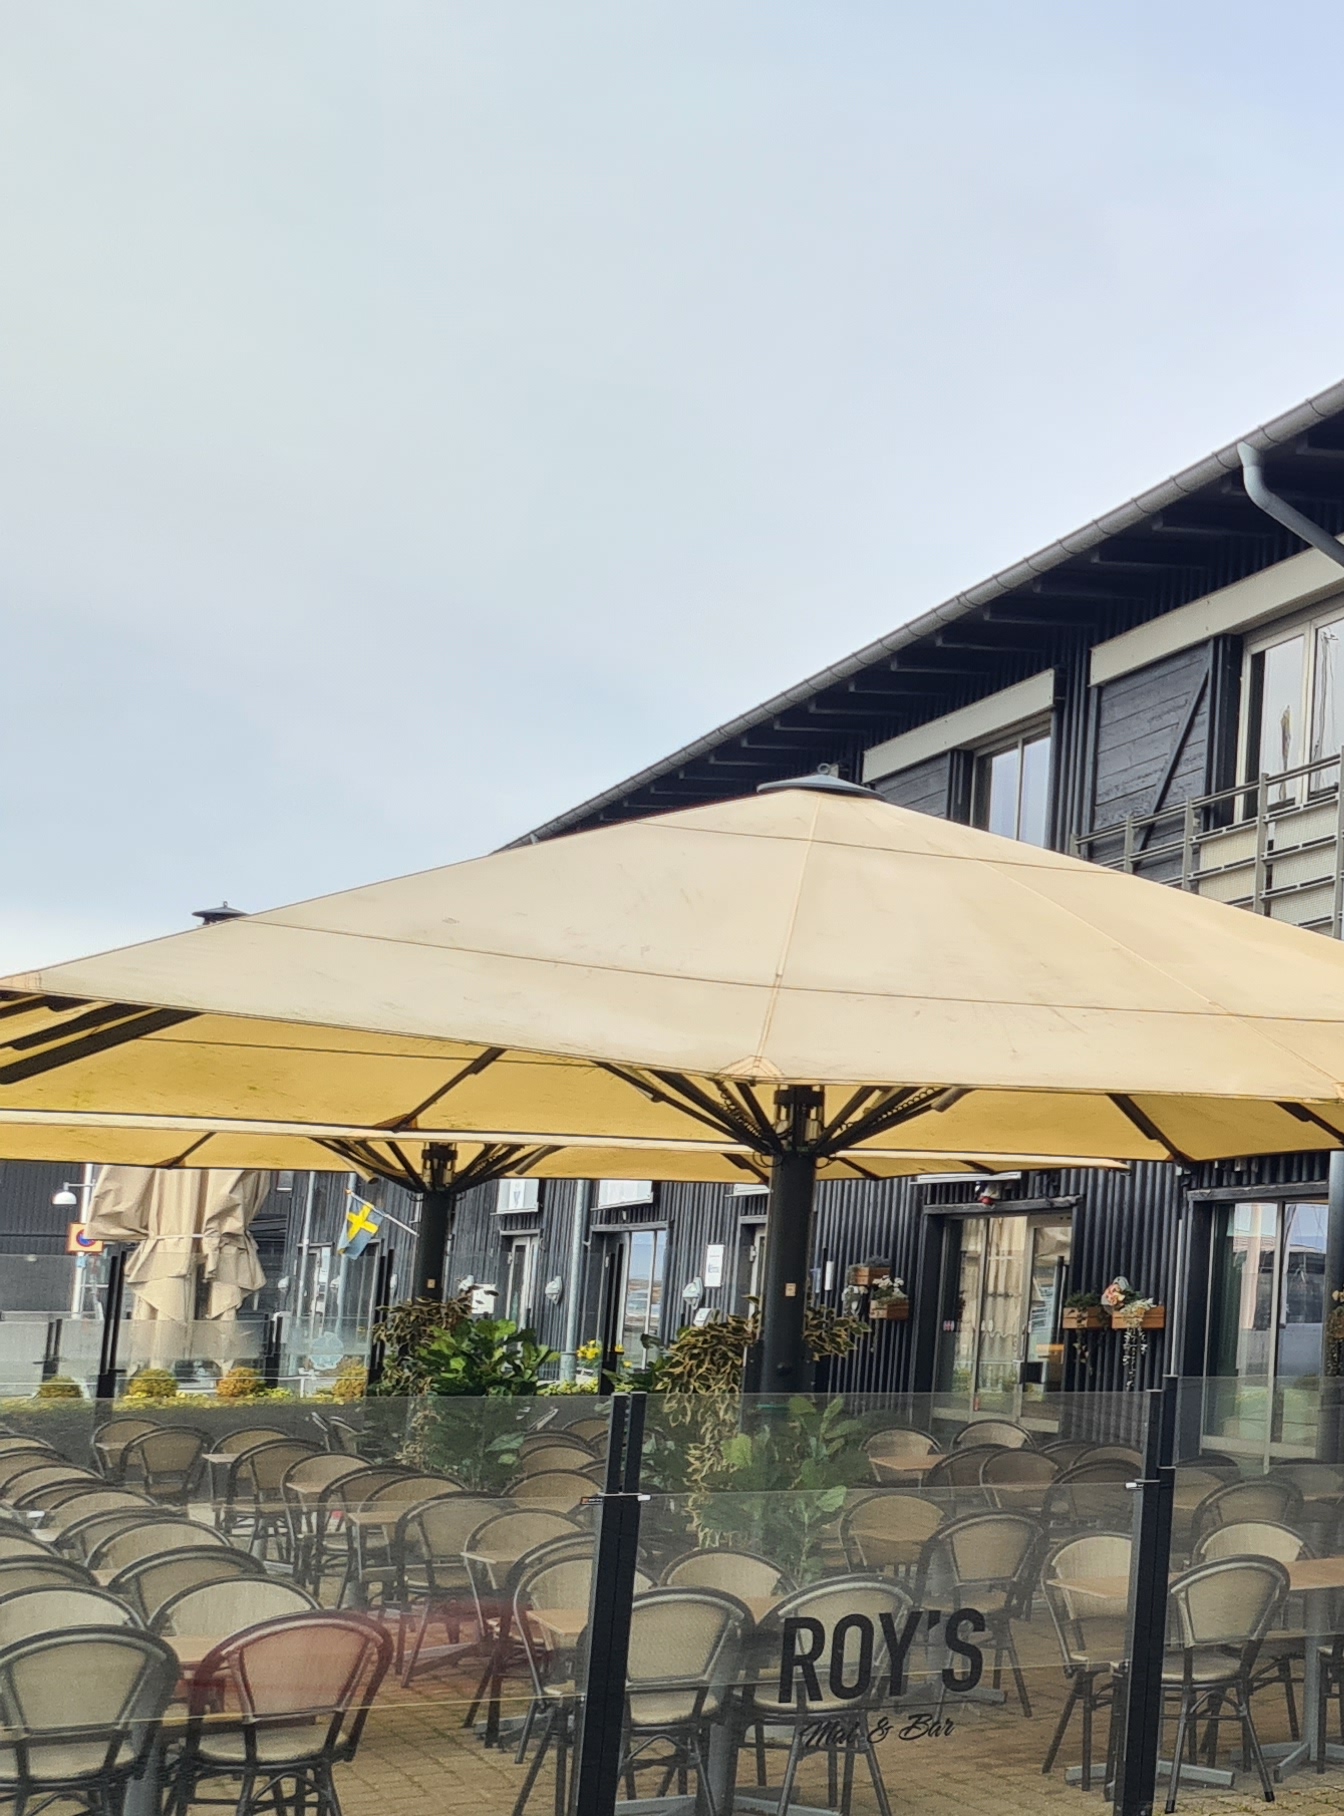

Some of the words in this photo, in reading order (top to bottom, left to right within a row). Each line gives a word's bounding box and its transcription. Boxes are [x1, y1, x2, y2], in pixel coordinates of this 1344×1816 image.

[778, 1607, 986, 1703] ROY'S
[867, 1716, 894, 1744] &
[899, 1713, 956, 1741] Bar
